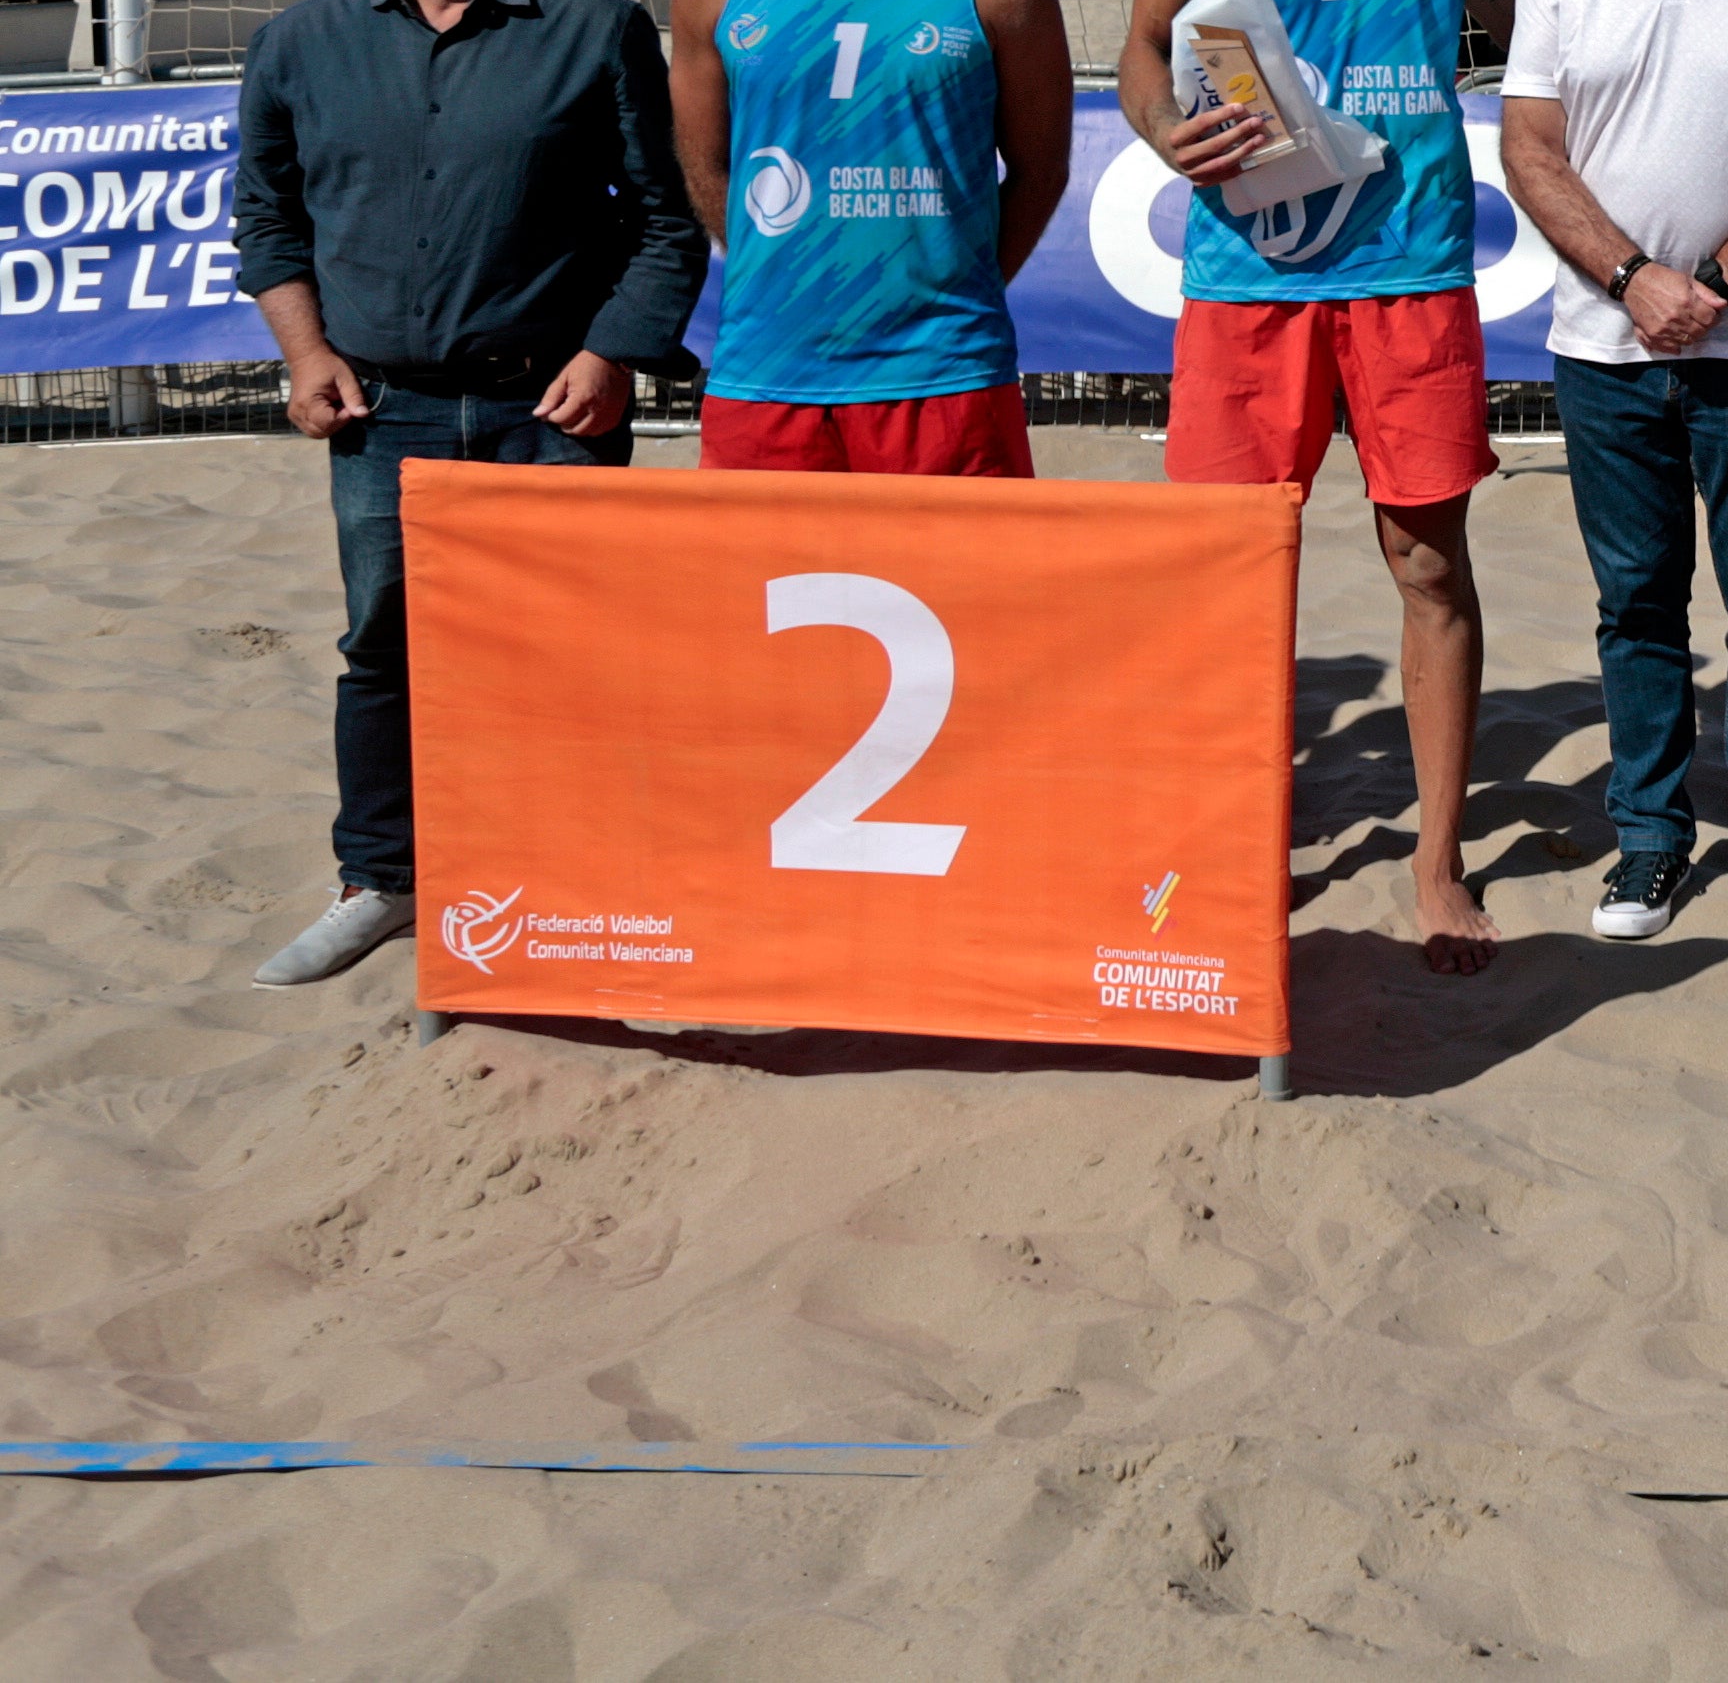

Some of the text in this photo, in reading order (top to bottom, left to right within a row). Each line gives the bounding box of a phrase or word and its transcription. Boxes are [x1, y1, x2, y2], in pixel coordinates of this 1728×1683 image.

[828, 21, 870, 100] 1
[1342, 64, 1395, 90] COSTA
[1341, 91, 1400, 117] BEACH
[829, 166, 885, 191] COSTA
[828, 193, 891, 219] BEACH
[0, 248, 111, 316] DE
[764, 571, 968, 877] 2
[527, 912, 673, 936] Federació Voleibol
[527, 939, 694, 964] Comunitat Valenciana
[1096, 945, 1225, 969] Comunitat Valenciana
[1093, 961, 1225, 993] COMUNITAT
[1100, 985, 1240, 1016] DE L'ESPORT
